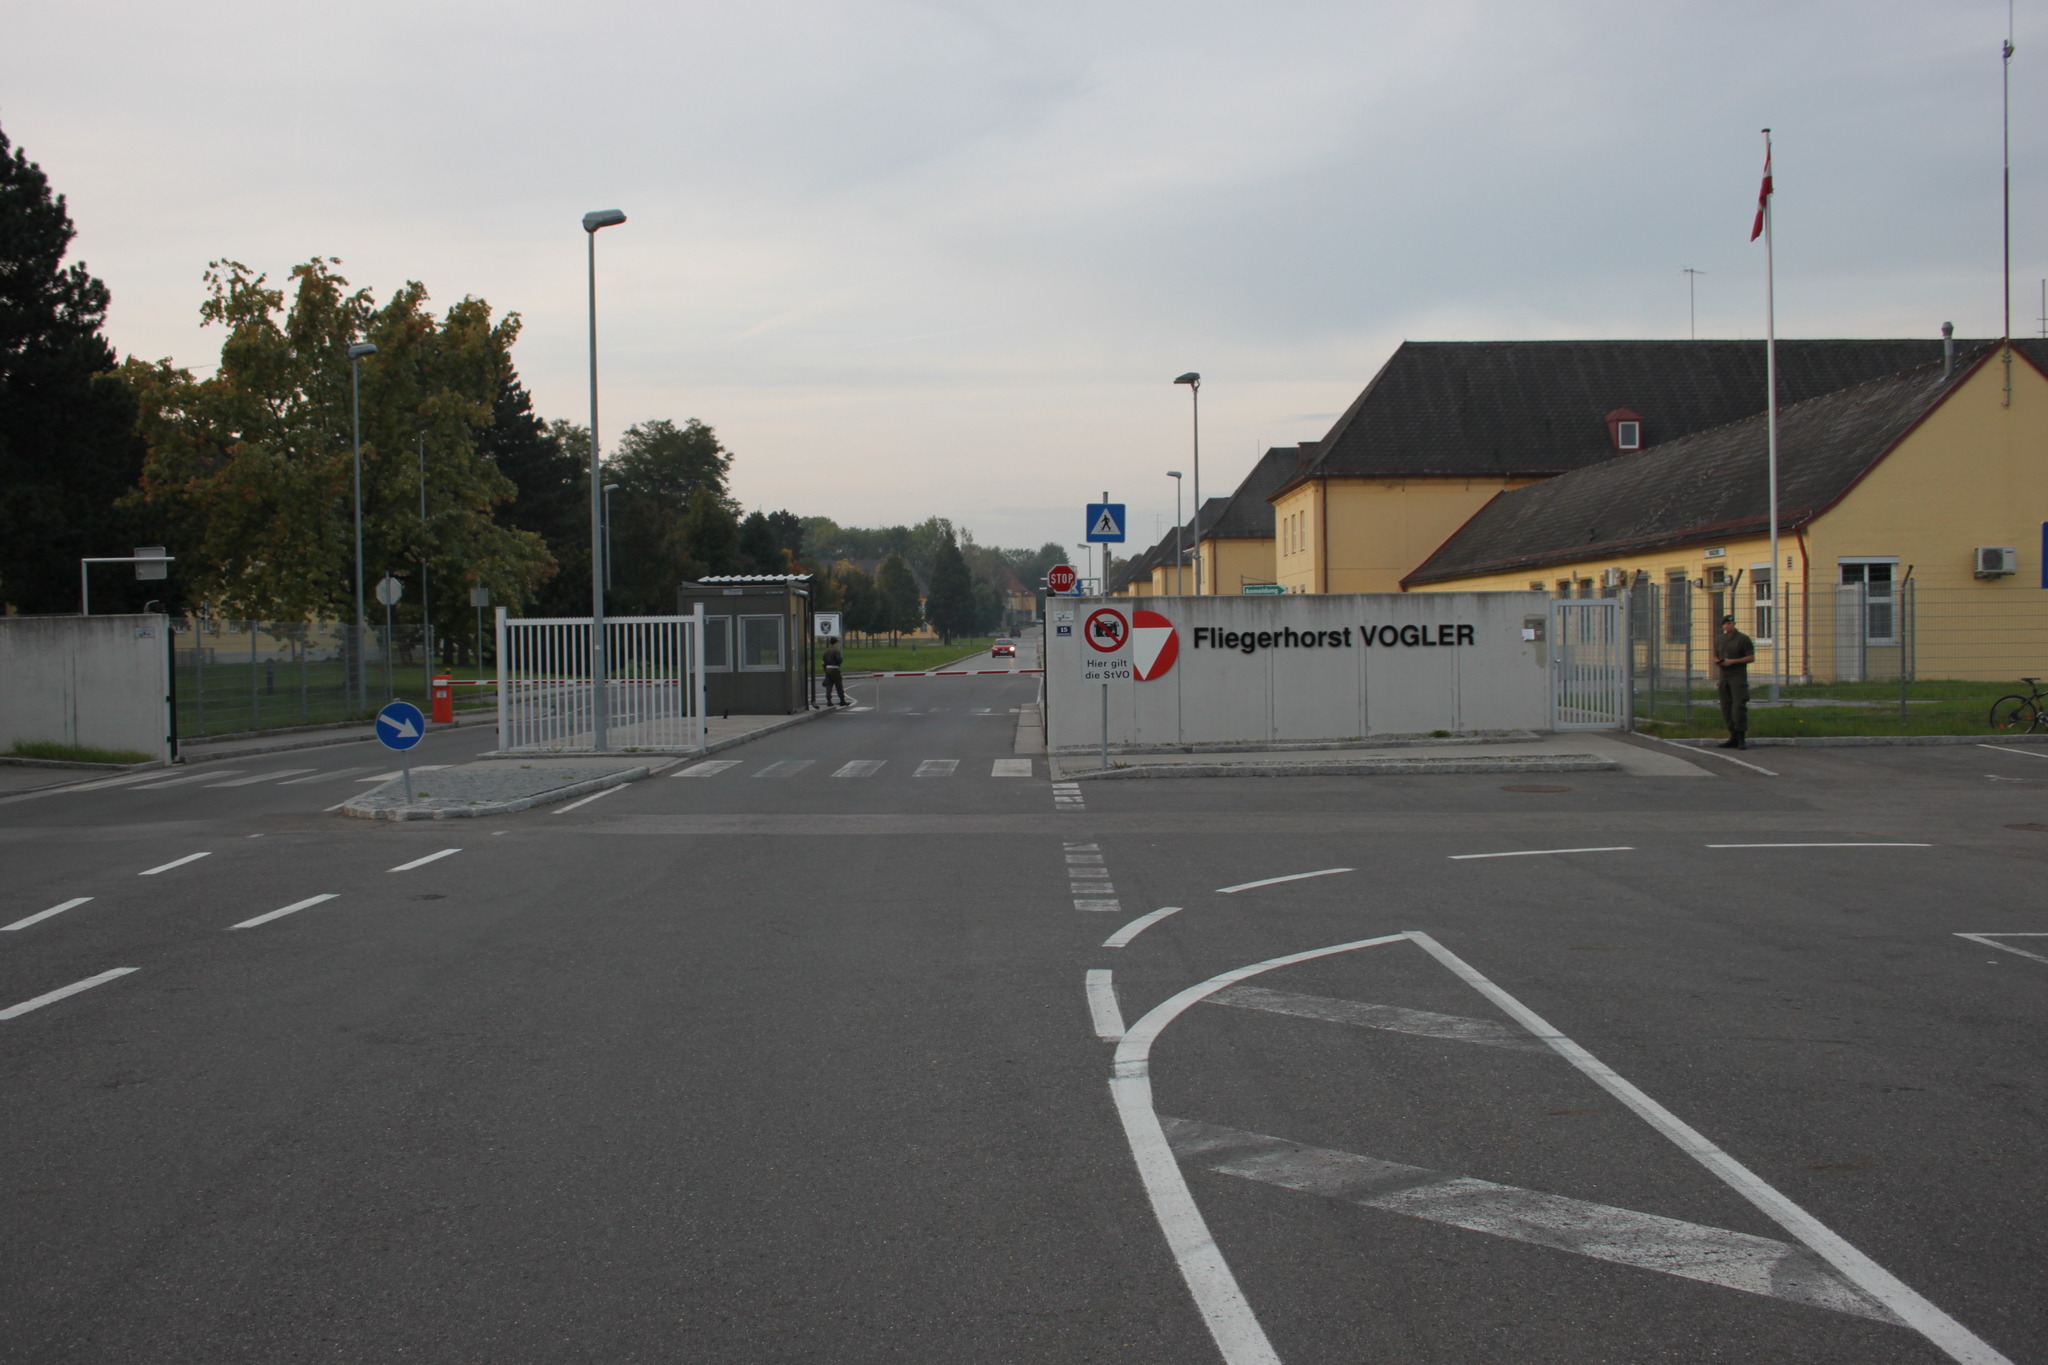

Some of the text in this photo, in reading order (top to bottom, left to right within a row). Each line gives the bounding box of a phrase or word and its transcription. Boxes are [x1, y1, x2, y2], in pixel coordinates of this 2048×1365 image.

[1050, 573, 1074, 585] STOP
[1193, 624, 1475, 654] Fliegerhorst VOGLER
[1087, 658, 1128, 670] Hier gilt
[1085, 670, 1130, 680] die StVO
